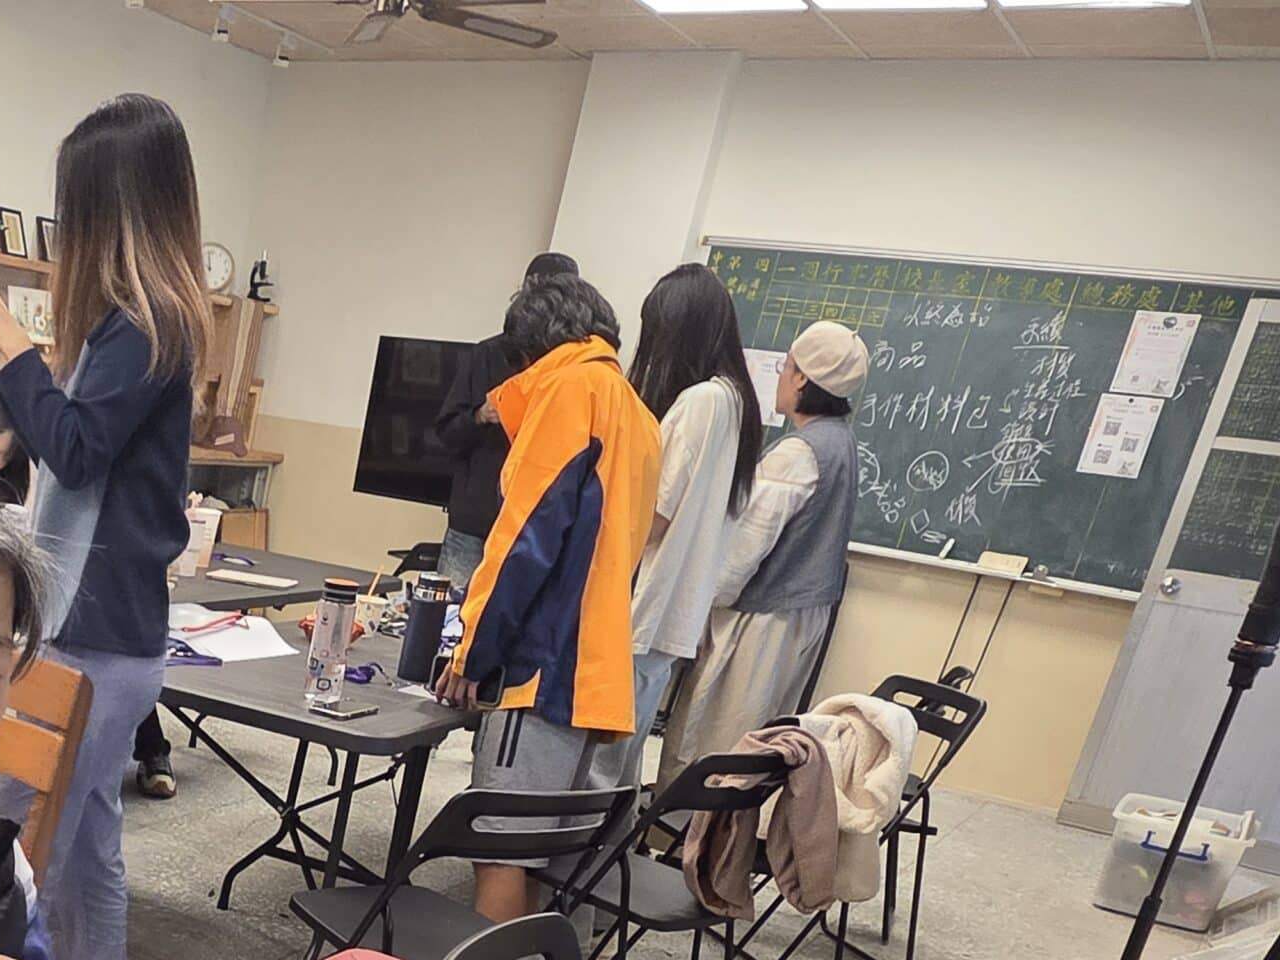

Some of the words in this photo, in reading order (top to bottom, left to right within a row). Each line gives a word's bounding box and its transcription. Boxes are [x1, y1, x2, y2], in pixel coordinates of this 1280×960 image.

[1081, 281, 1163, 312] 總務處
[1182, 290, 1237, 317] 其他
[861, 384, 992, 435] 手作材料包
